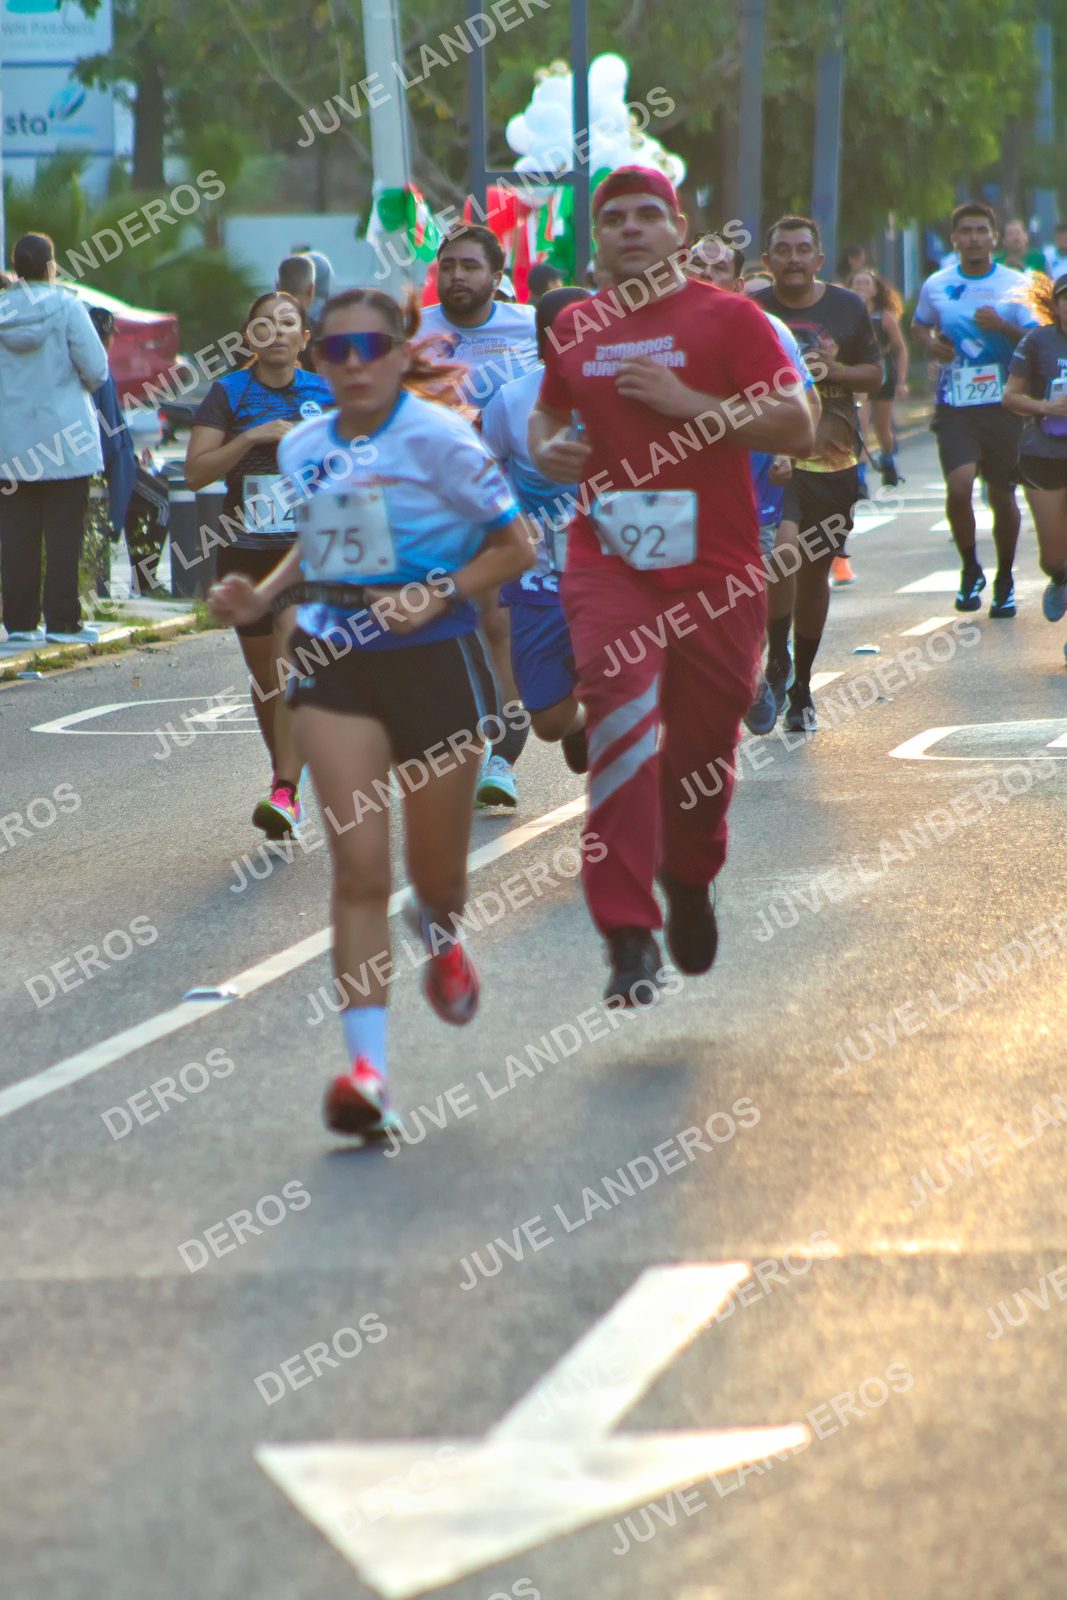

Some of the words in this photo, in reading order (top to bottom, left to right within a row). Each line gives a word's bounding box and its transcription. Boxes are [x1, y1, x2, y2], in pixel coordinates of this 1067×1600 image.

[956, 381, 1000, 401] 1292
[317, 529, 365, 568] 75
[620, 524, 667, 559] 92
